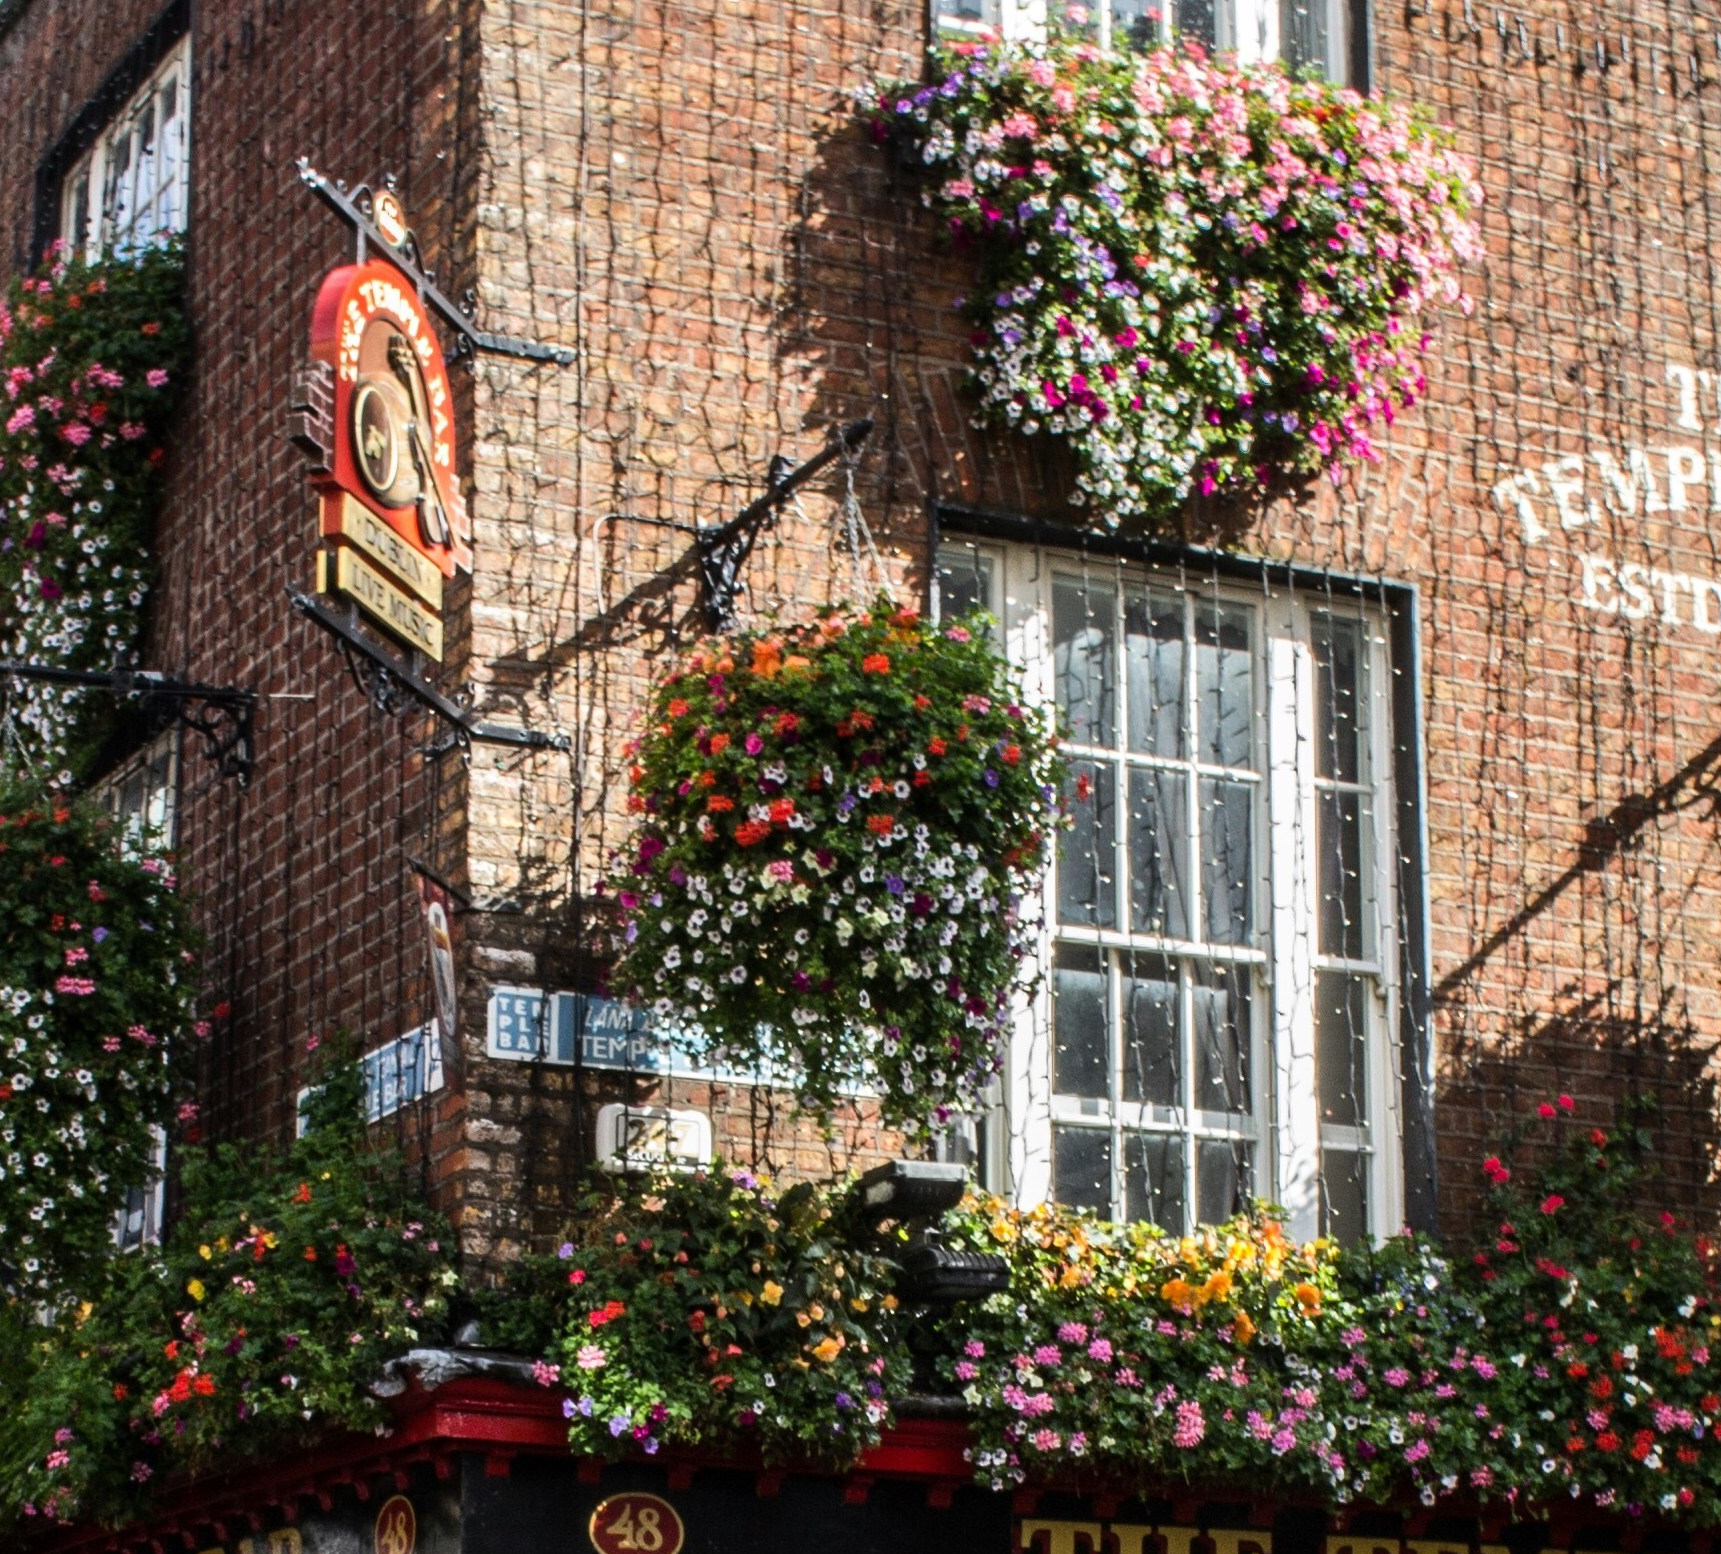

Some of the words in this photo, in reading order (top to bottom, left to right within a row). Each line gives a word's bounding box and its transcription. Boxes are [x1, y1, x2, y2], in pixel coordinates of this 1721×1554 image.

[358, 280, 433, 365] TEMPLE
[428, 371, 450, 467] BAR
[364, 518, 422, 583] DUBLIN
[352, 566, 388, 618] LIVE
[390, 596, 433, 647] MUSIC
[580, 1034, 649, 1062] TEMP
[607, 1502, 664, 1552] 48
